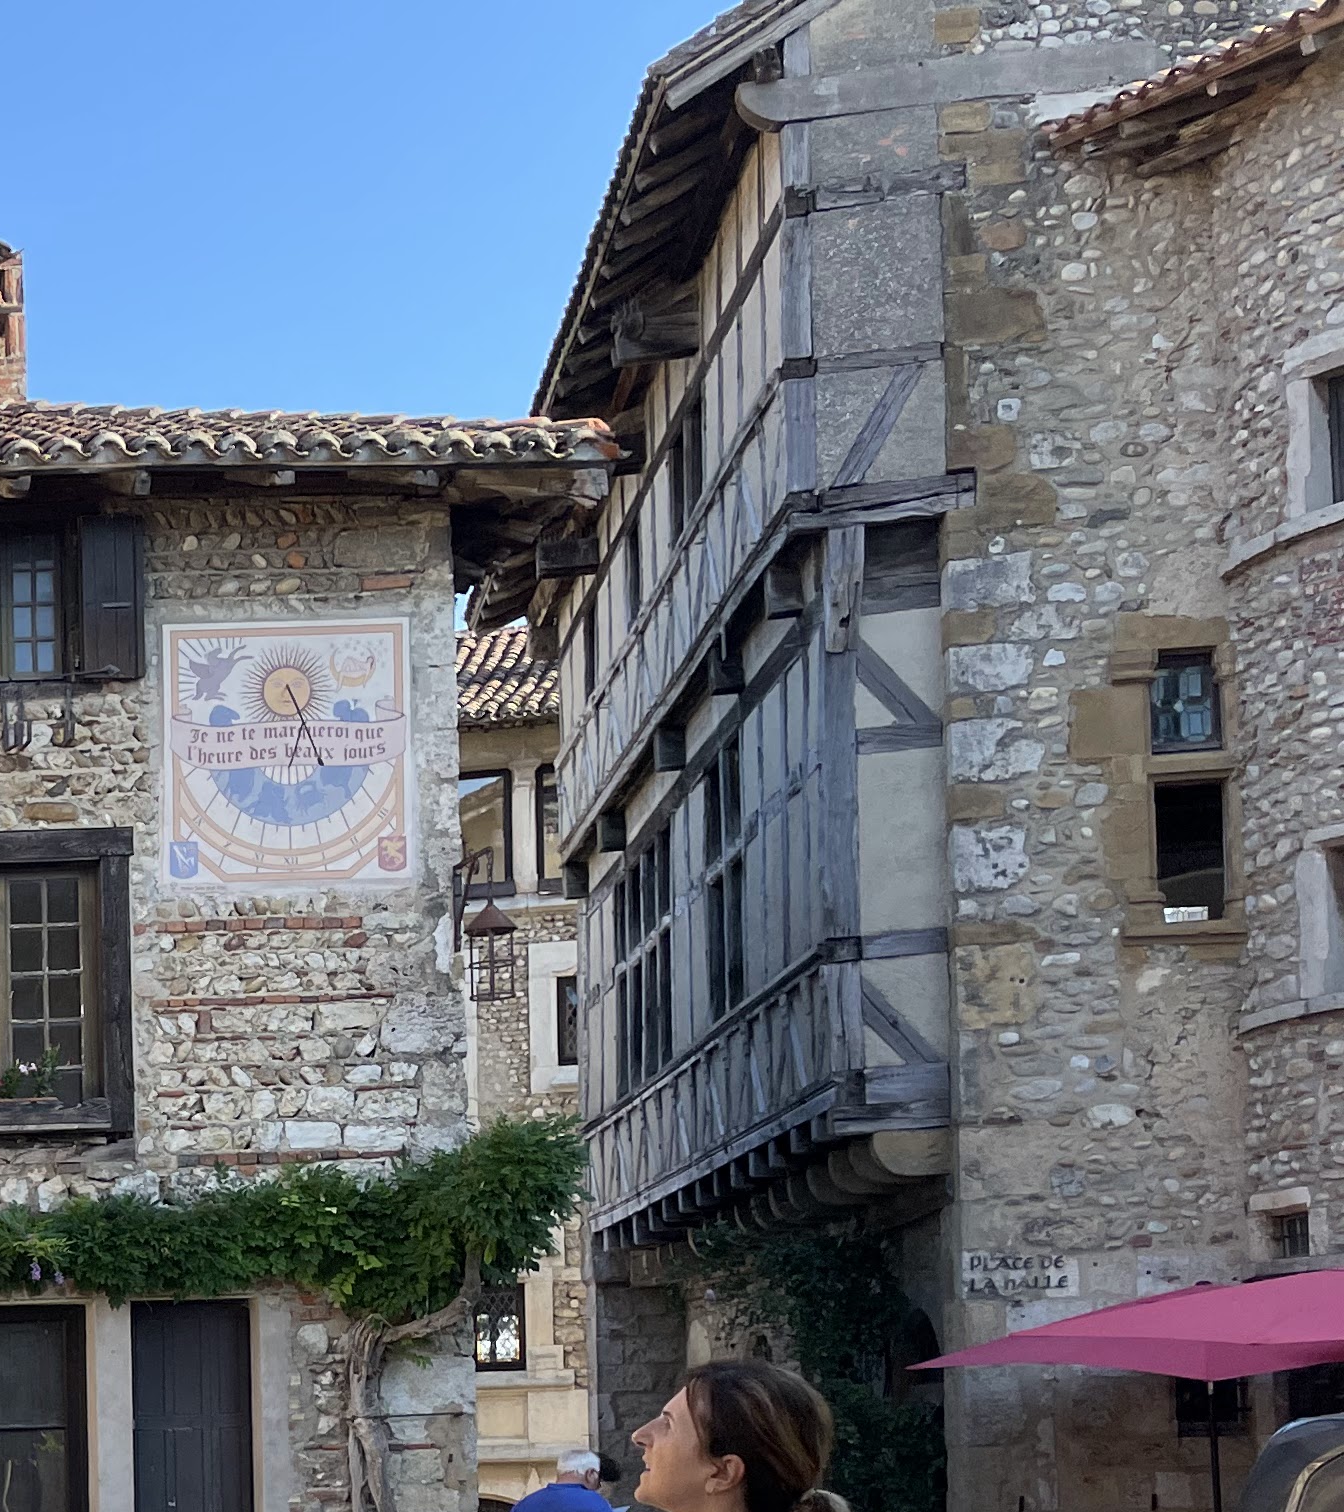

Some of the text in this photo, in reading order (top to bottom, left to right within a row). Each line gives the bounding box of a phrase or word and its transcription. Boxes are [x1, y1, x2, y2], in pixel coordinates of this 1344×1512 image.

[190, 729, 209, 744] Je
[216, 730, 235, 743] ne
[241, 726, 256, 741] te
[355, 727, 384, 743] que
[187, 741, 387, 766] l'heure des beaux jours
[283, 856, 299, 866] XII
[969, 1254, 1065, 1272] PLACE DE
[969, 1276, 999, 1292] LA
